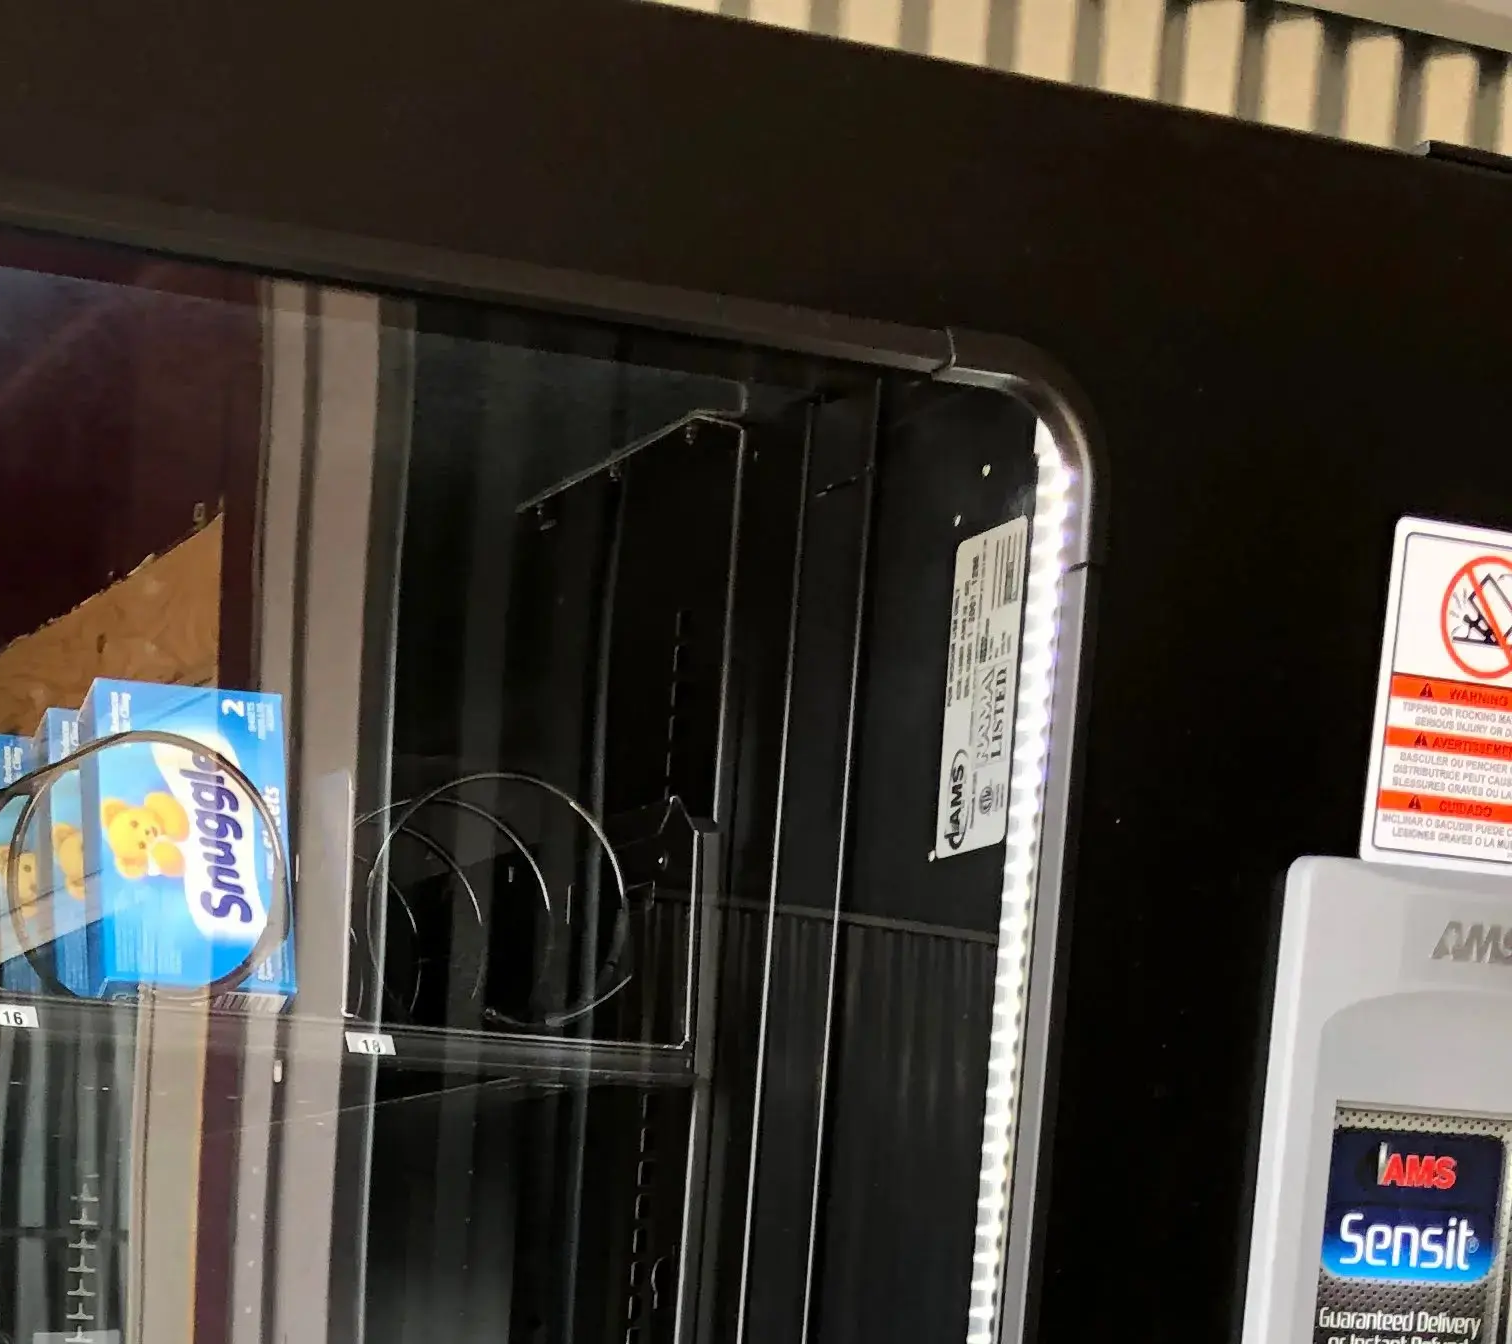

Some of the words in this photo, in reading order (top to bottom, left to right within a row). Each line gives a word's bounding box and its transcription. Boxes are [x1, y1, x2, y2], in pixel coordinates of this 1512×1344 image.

[1449, 688, 1508, 707] WARNING
[222, 699, 244, 718] 2
[991, 666, 1008, 761] LISTED
[1403, 702, 1438, 716] TIPPING
[1440, 706, 1455, 717] OR
[1456, 708, 1496, 723] ROCKING
[1490, 724, 1503, 737] OR
[1400, 752, 1449, 766] BASCULER
[1450, 757, 1464, 769] OU
[1466, 760, 1508, 775] PENCHER
[1463, 772, 1486, 785] PEUT
[949, 762, 965, 832] AMS
[1485, 787, 1502, 799] OU
[1439, 800, 1493, 818] CUIDADO
[1426, 817, 1434, 828] O
[1475, 823, 1505, 837] PUEDE
[1475, 834, 1485, 847] O
[1486, 836, 1497, 849] LA
[2, 1009, 24, 1026] 16
[361, 1037, 383, 1052] 18
[1383, 1153, 1457, 1189] AMS
[1319, 1306, 1413, 1334] Guaranteed
[1417, 1312, 1481, 1340] Delivery
